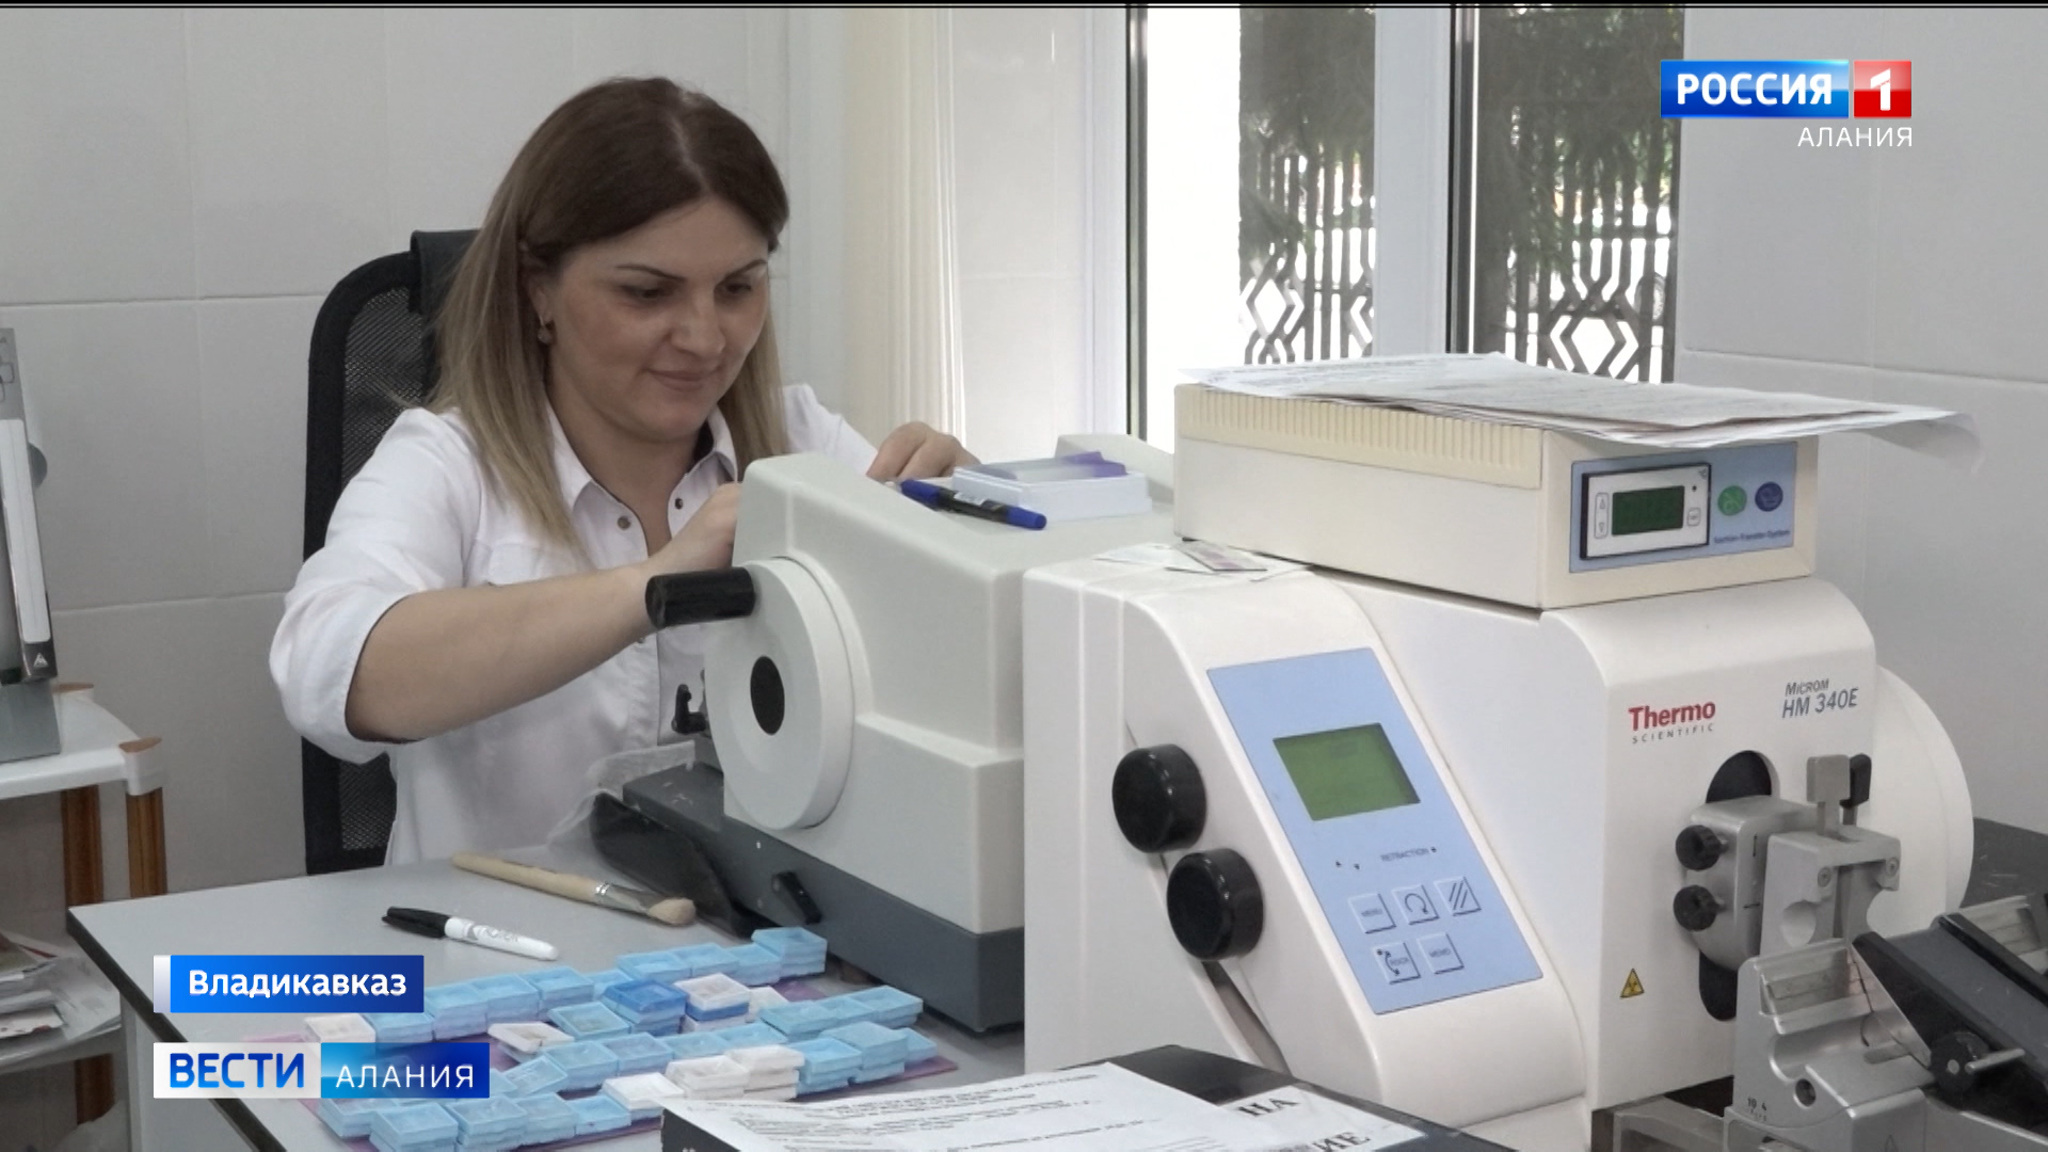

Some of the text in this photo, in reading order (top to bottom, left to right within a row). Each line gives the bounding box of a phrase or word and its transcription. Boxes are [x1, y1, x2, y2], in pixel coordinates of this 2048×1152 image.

[1628, 701, 1716, 731] Thermo
[1782, 687, 1859, 718] HM 340E
[1632, 723, 1714, 744] SCIENTIFIC
